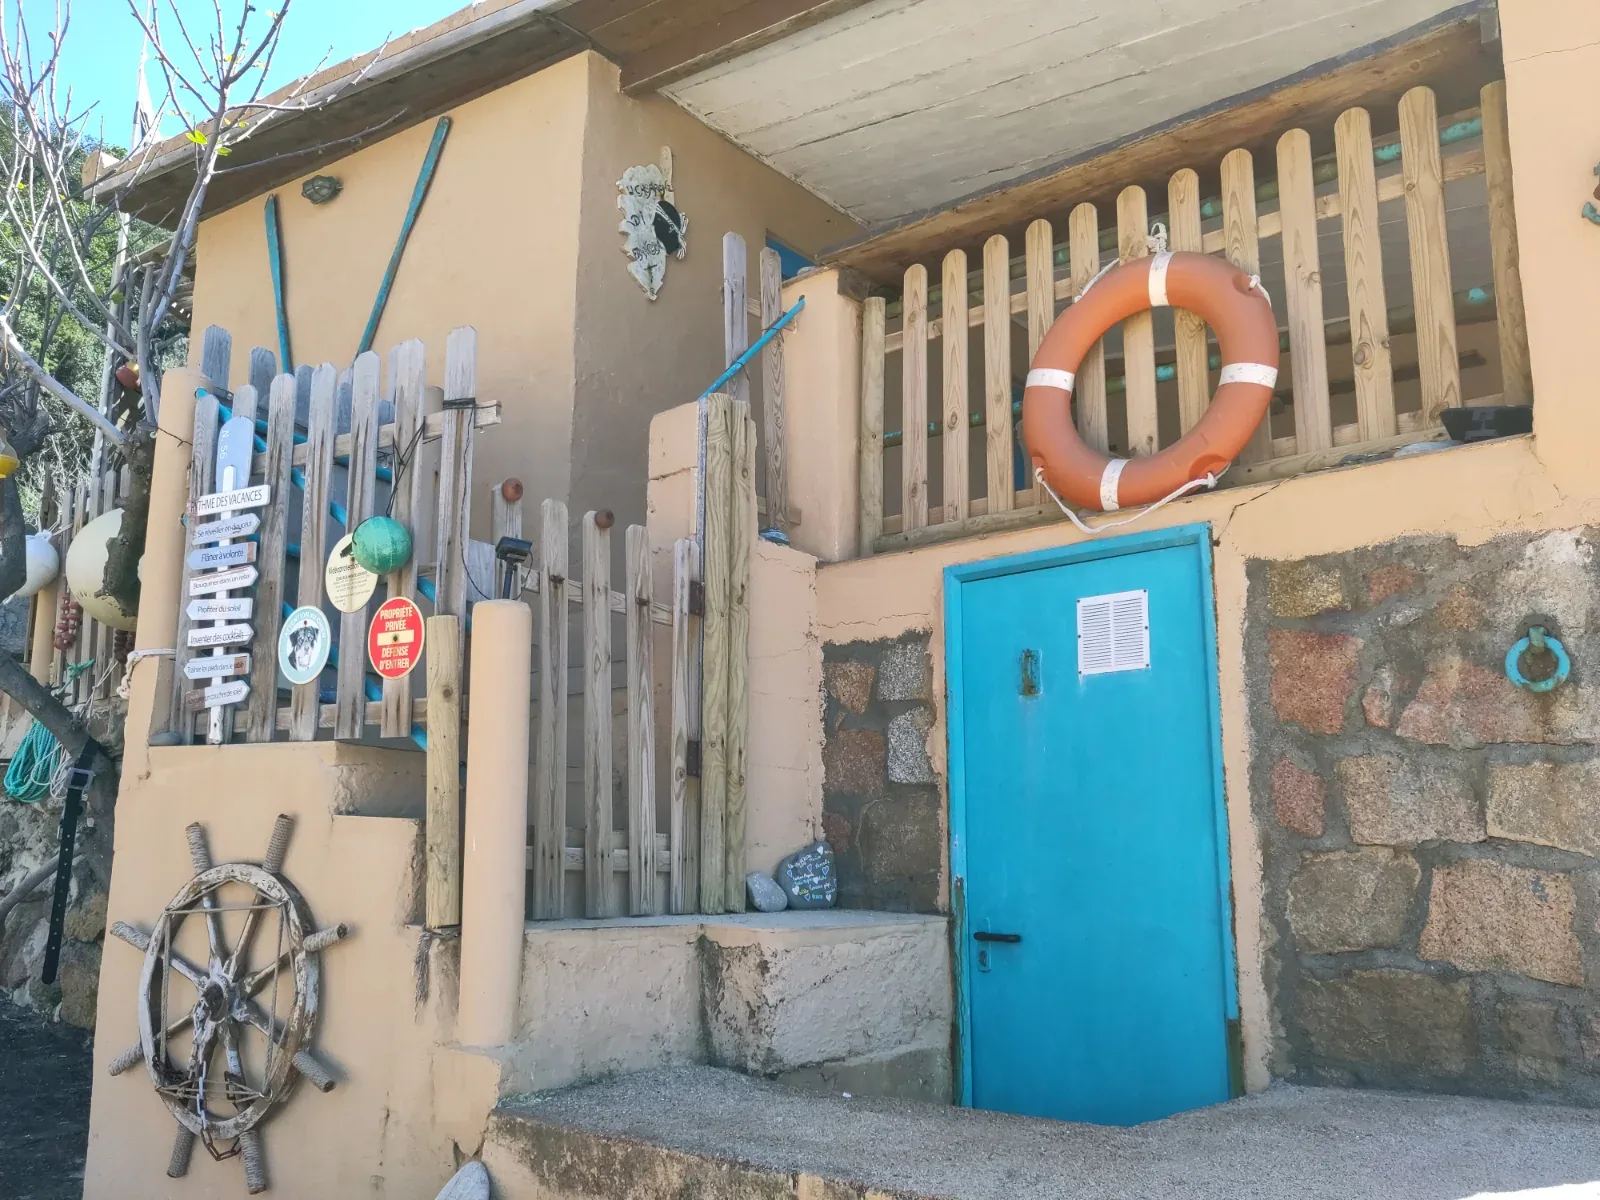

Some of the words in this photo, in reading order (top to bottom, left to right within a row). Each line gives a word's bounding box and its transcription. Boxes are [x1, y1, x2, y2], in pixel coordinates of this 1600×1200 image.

[216, 494, 229, 508] DES
[229, 488, 263, 506] VACANCES
[197, 530, 205, 538] Se
[205, 524, 224, 537] réveiller
[224, 524, 232, 533] en
[231, 519, 253, 532] douceur
[201, 551, 218, 562] Flâner
[218, 550, 223, 560] à
[223, 547, 244, 559] volonté
[193, 580, 219, 590] Bouquiner
[219, 577, 231, 586] dans
[231, 575, 238, 583] un
[238, 572, 251, 581] relax
[197, 603, 218, 615] Profiter
[218, 603, 227, 613] du
[227, 603, 242, 612] soleil
[380, 604, 413, 620] PROPRIÉTÉ
[385, 618, 407, 631] PRIVÉE
[190, 634, 213, 645] Inventer
[213, 632, 222, 643] des
[222, 629, 245, 641] cocktails
[381, 645, 409, 658] DÉFENSE
[379, 658, 410, 671] D'ENTRER
